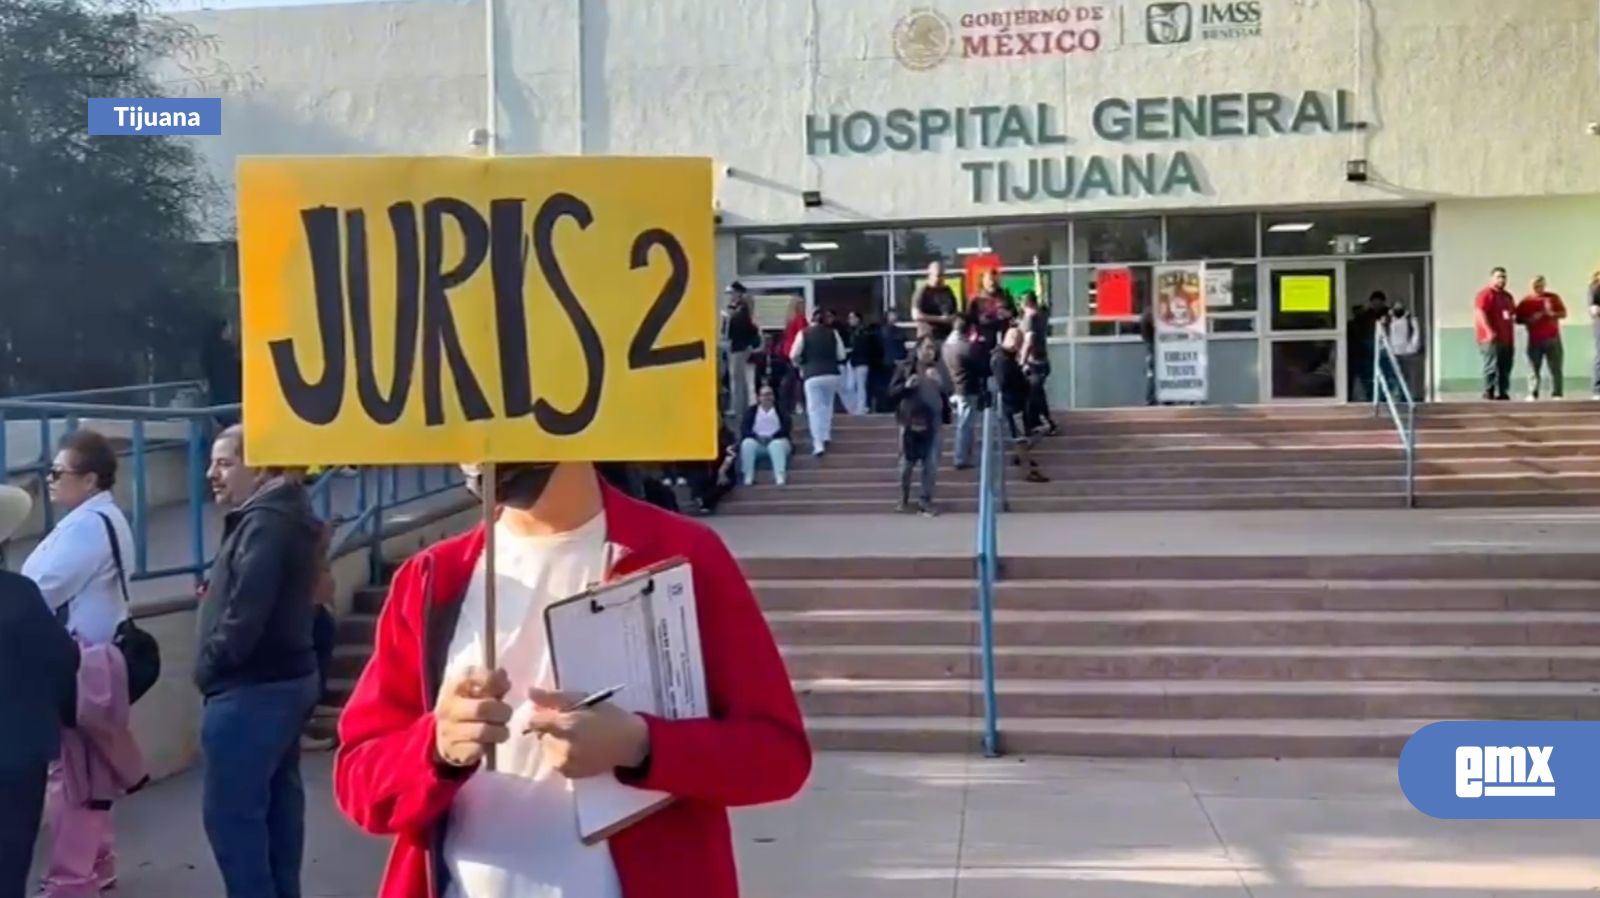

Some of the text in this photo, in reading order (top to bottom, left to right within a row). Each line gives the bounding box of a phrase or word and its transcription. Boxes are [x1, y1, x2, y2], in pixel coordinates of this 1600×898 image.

[960, 5, 1104, 28] GOBIERNO DE
[1201, 1, 1262, 25] IMSS
[961, 27, 1101, 58] MÉXICO
[805, 89, 1368, 156] HOSPITAL GENERAL
[961, 151, 1203, 204] TIJUANA
[268, 192, 706, 436] JURIS 2
